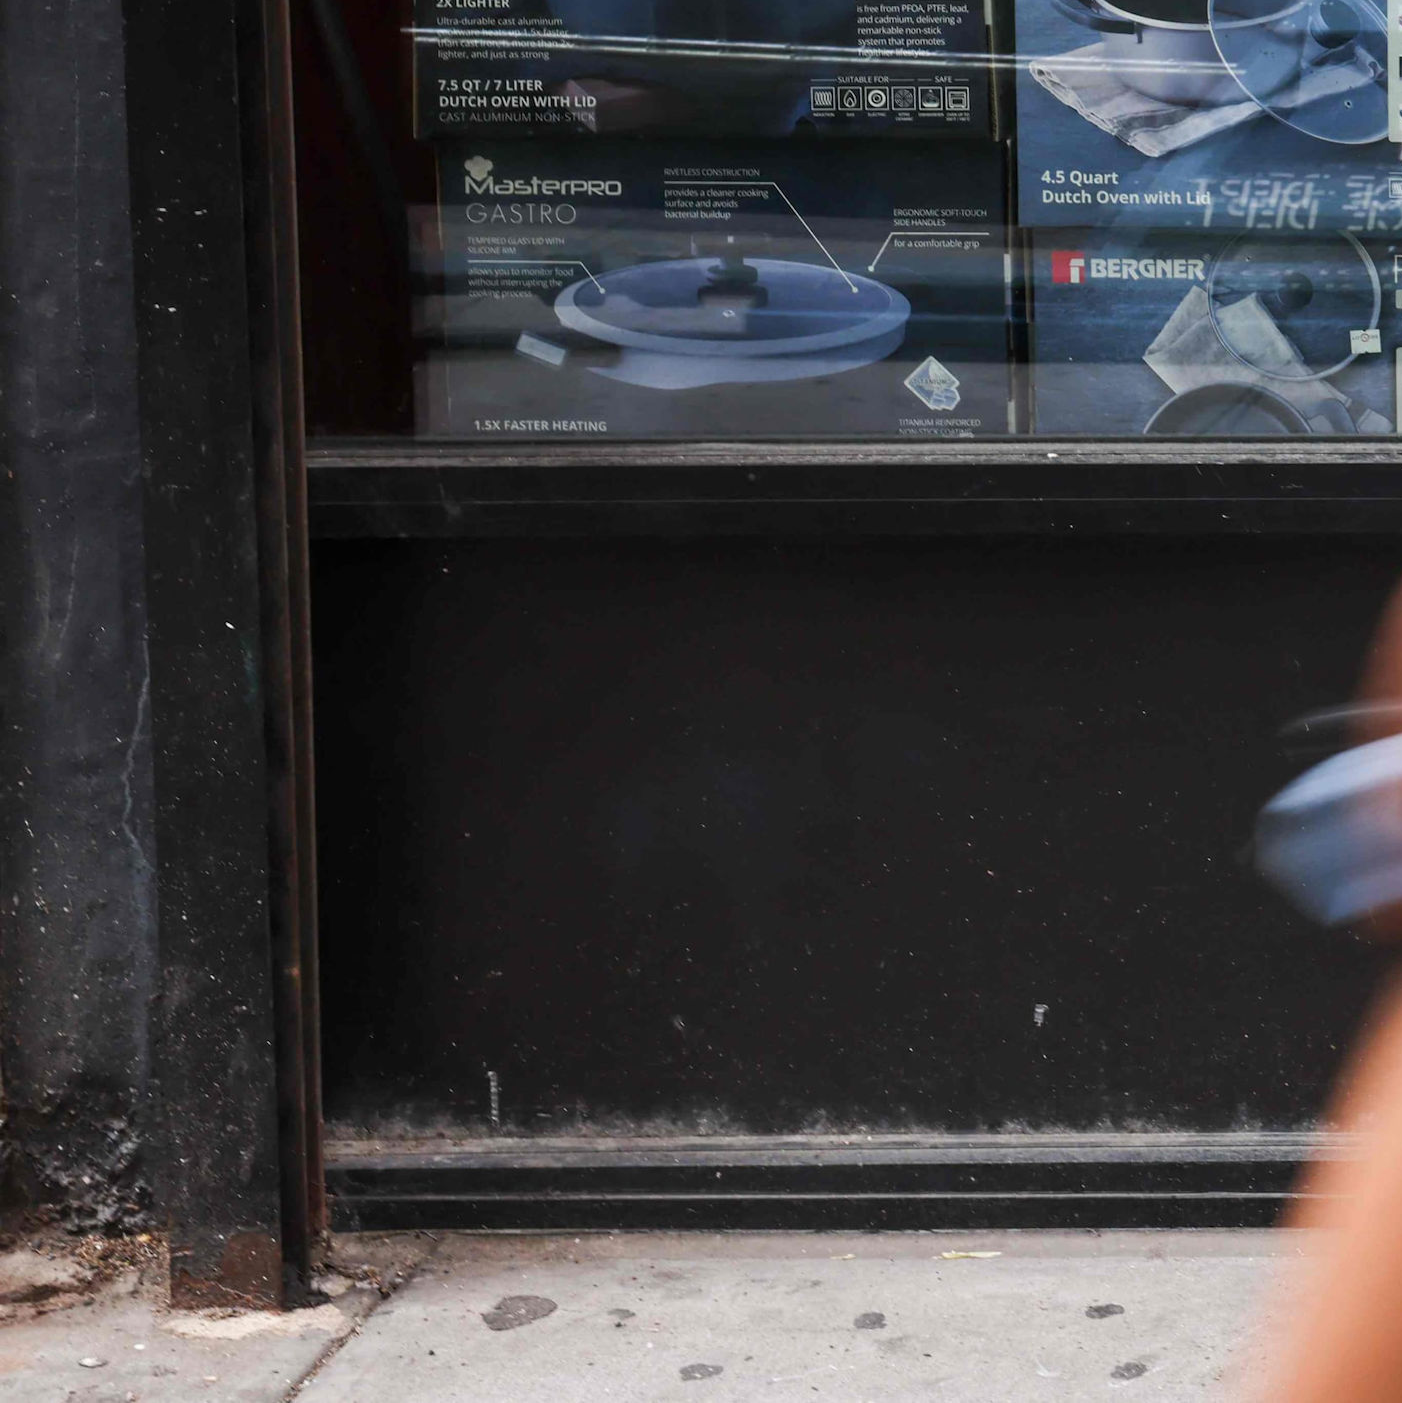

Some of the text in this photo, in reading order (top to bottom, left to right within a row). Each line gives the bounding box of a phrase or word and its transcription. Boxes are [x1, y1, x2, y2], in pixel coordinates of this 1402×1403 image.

[440, 96, 597, 107] DUTCH OVEN WITH LID
[1041, 170, 1119, 186] 4.5 Quart
[1042, 190, 1211, 205] Dutch Oven with Lid
[466, 202, 576, 224] GASTRO
[1091, 258, 1206, 281] BERGNER
